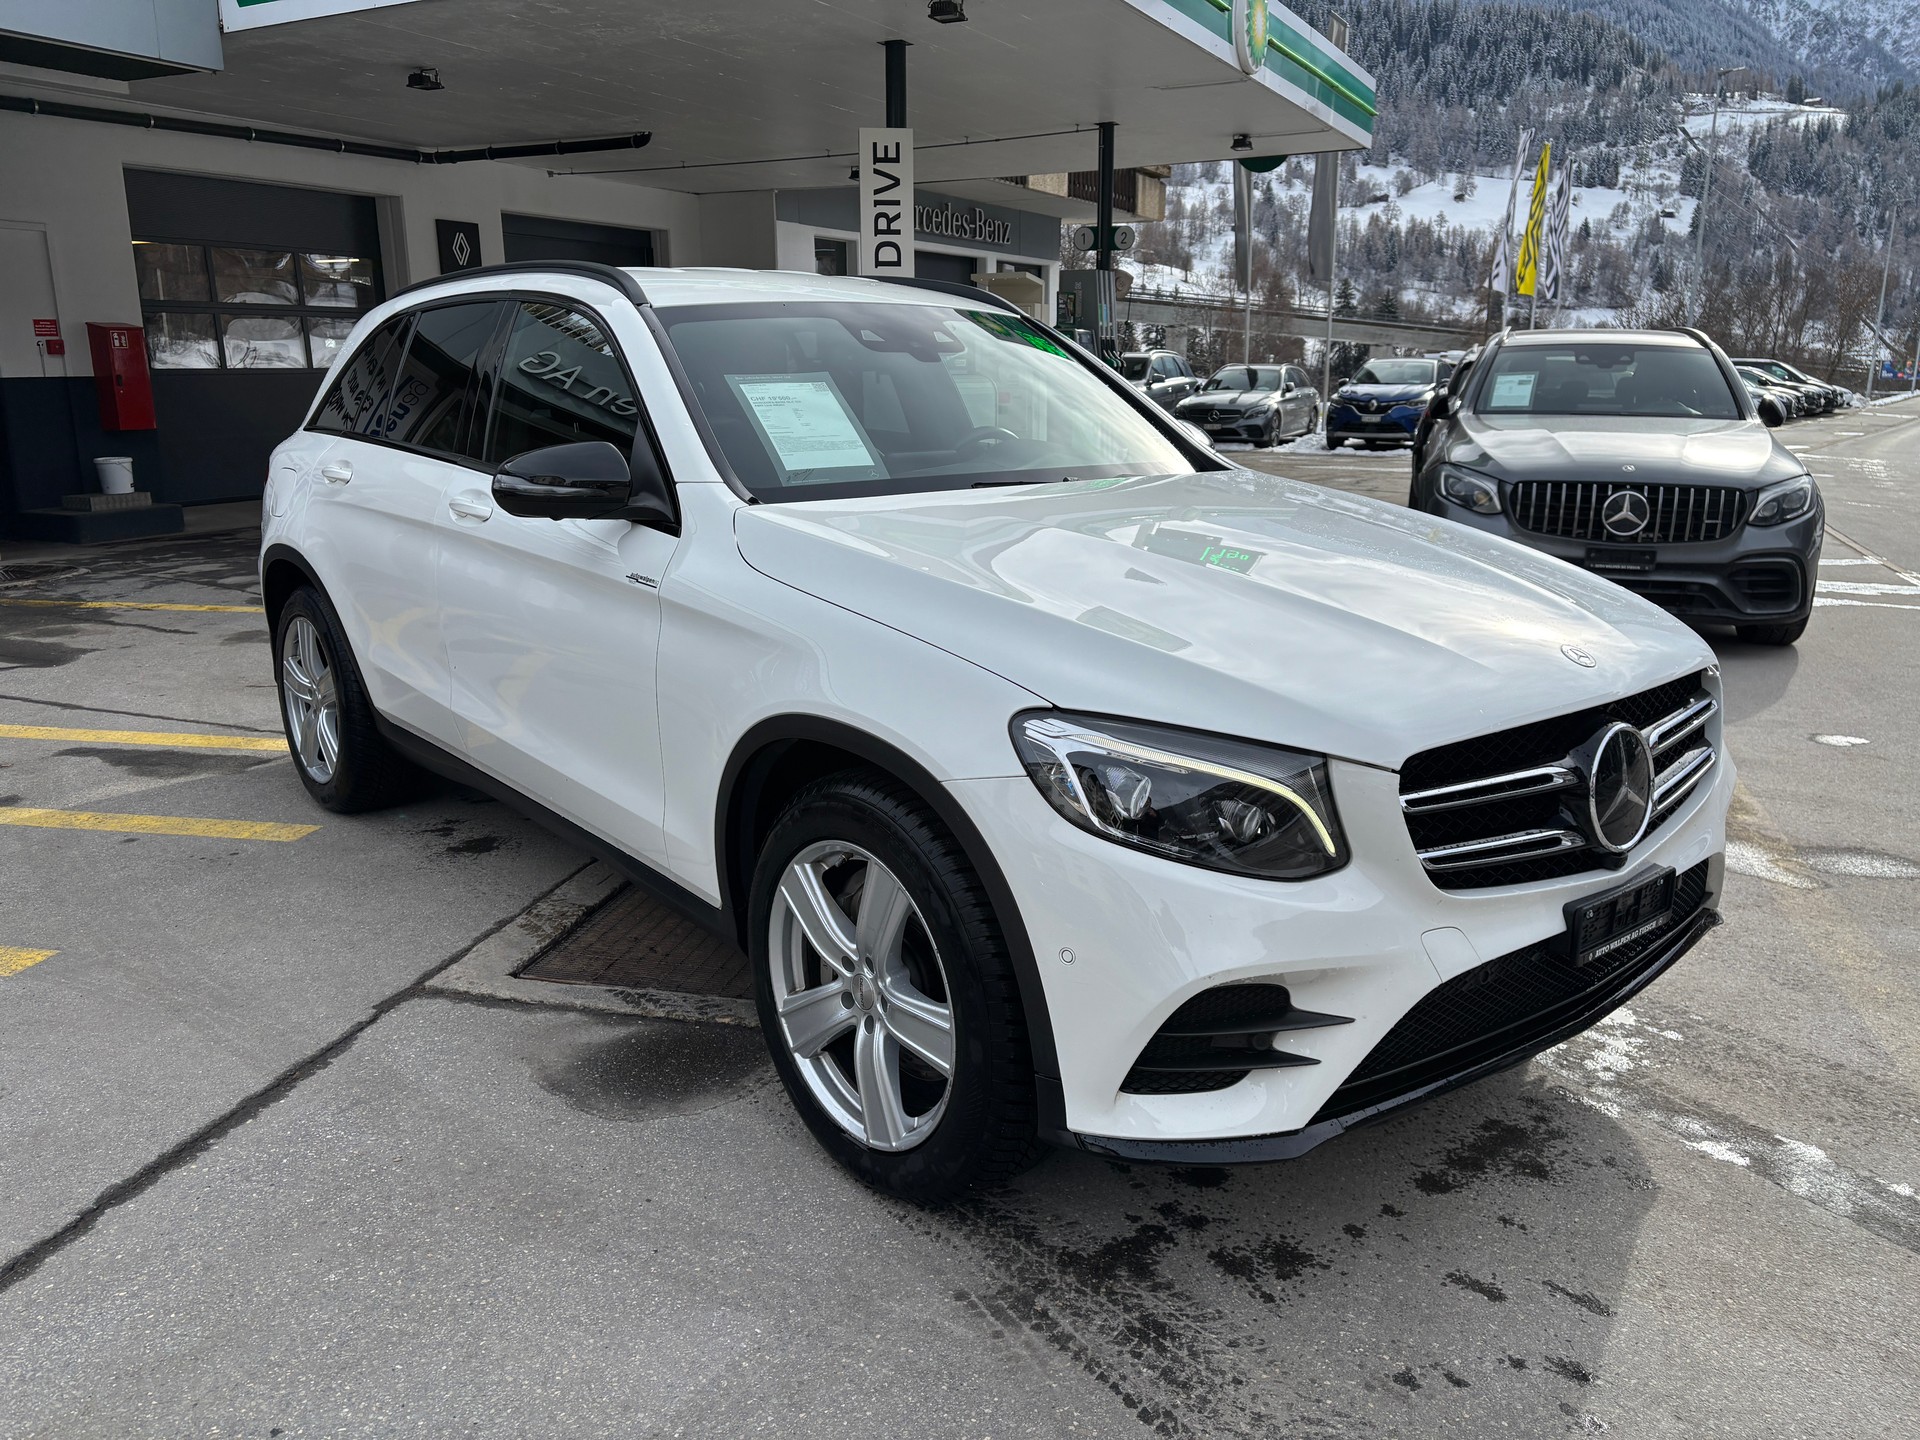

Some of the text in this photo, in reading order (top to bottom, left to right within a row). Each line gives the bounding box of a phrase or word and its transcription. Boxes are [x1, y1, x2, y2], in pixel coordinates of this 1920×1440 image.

[872, 141, 902, 269] DRIVE
[914, 203, 1012, 245] rcedes-Benz
[1081, 232, 1086, 245] 1
[1120, 231, 1128, 245] 2
[1595, 945, 1610, 957] AUTO
[1610, 934, 1632, 949] WALPEN
[1631, 930, 1640, 940] AG
